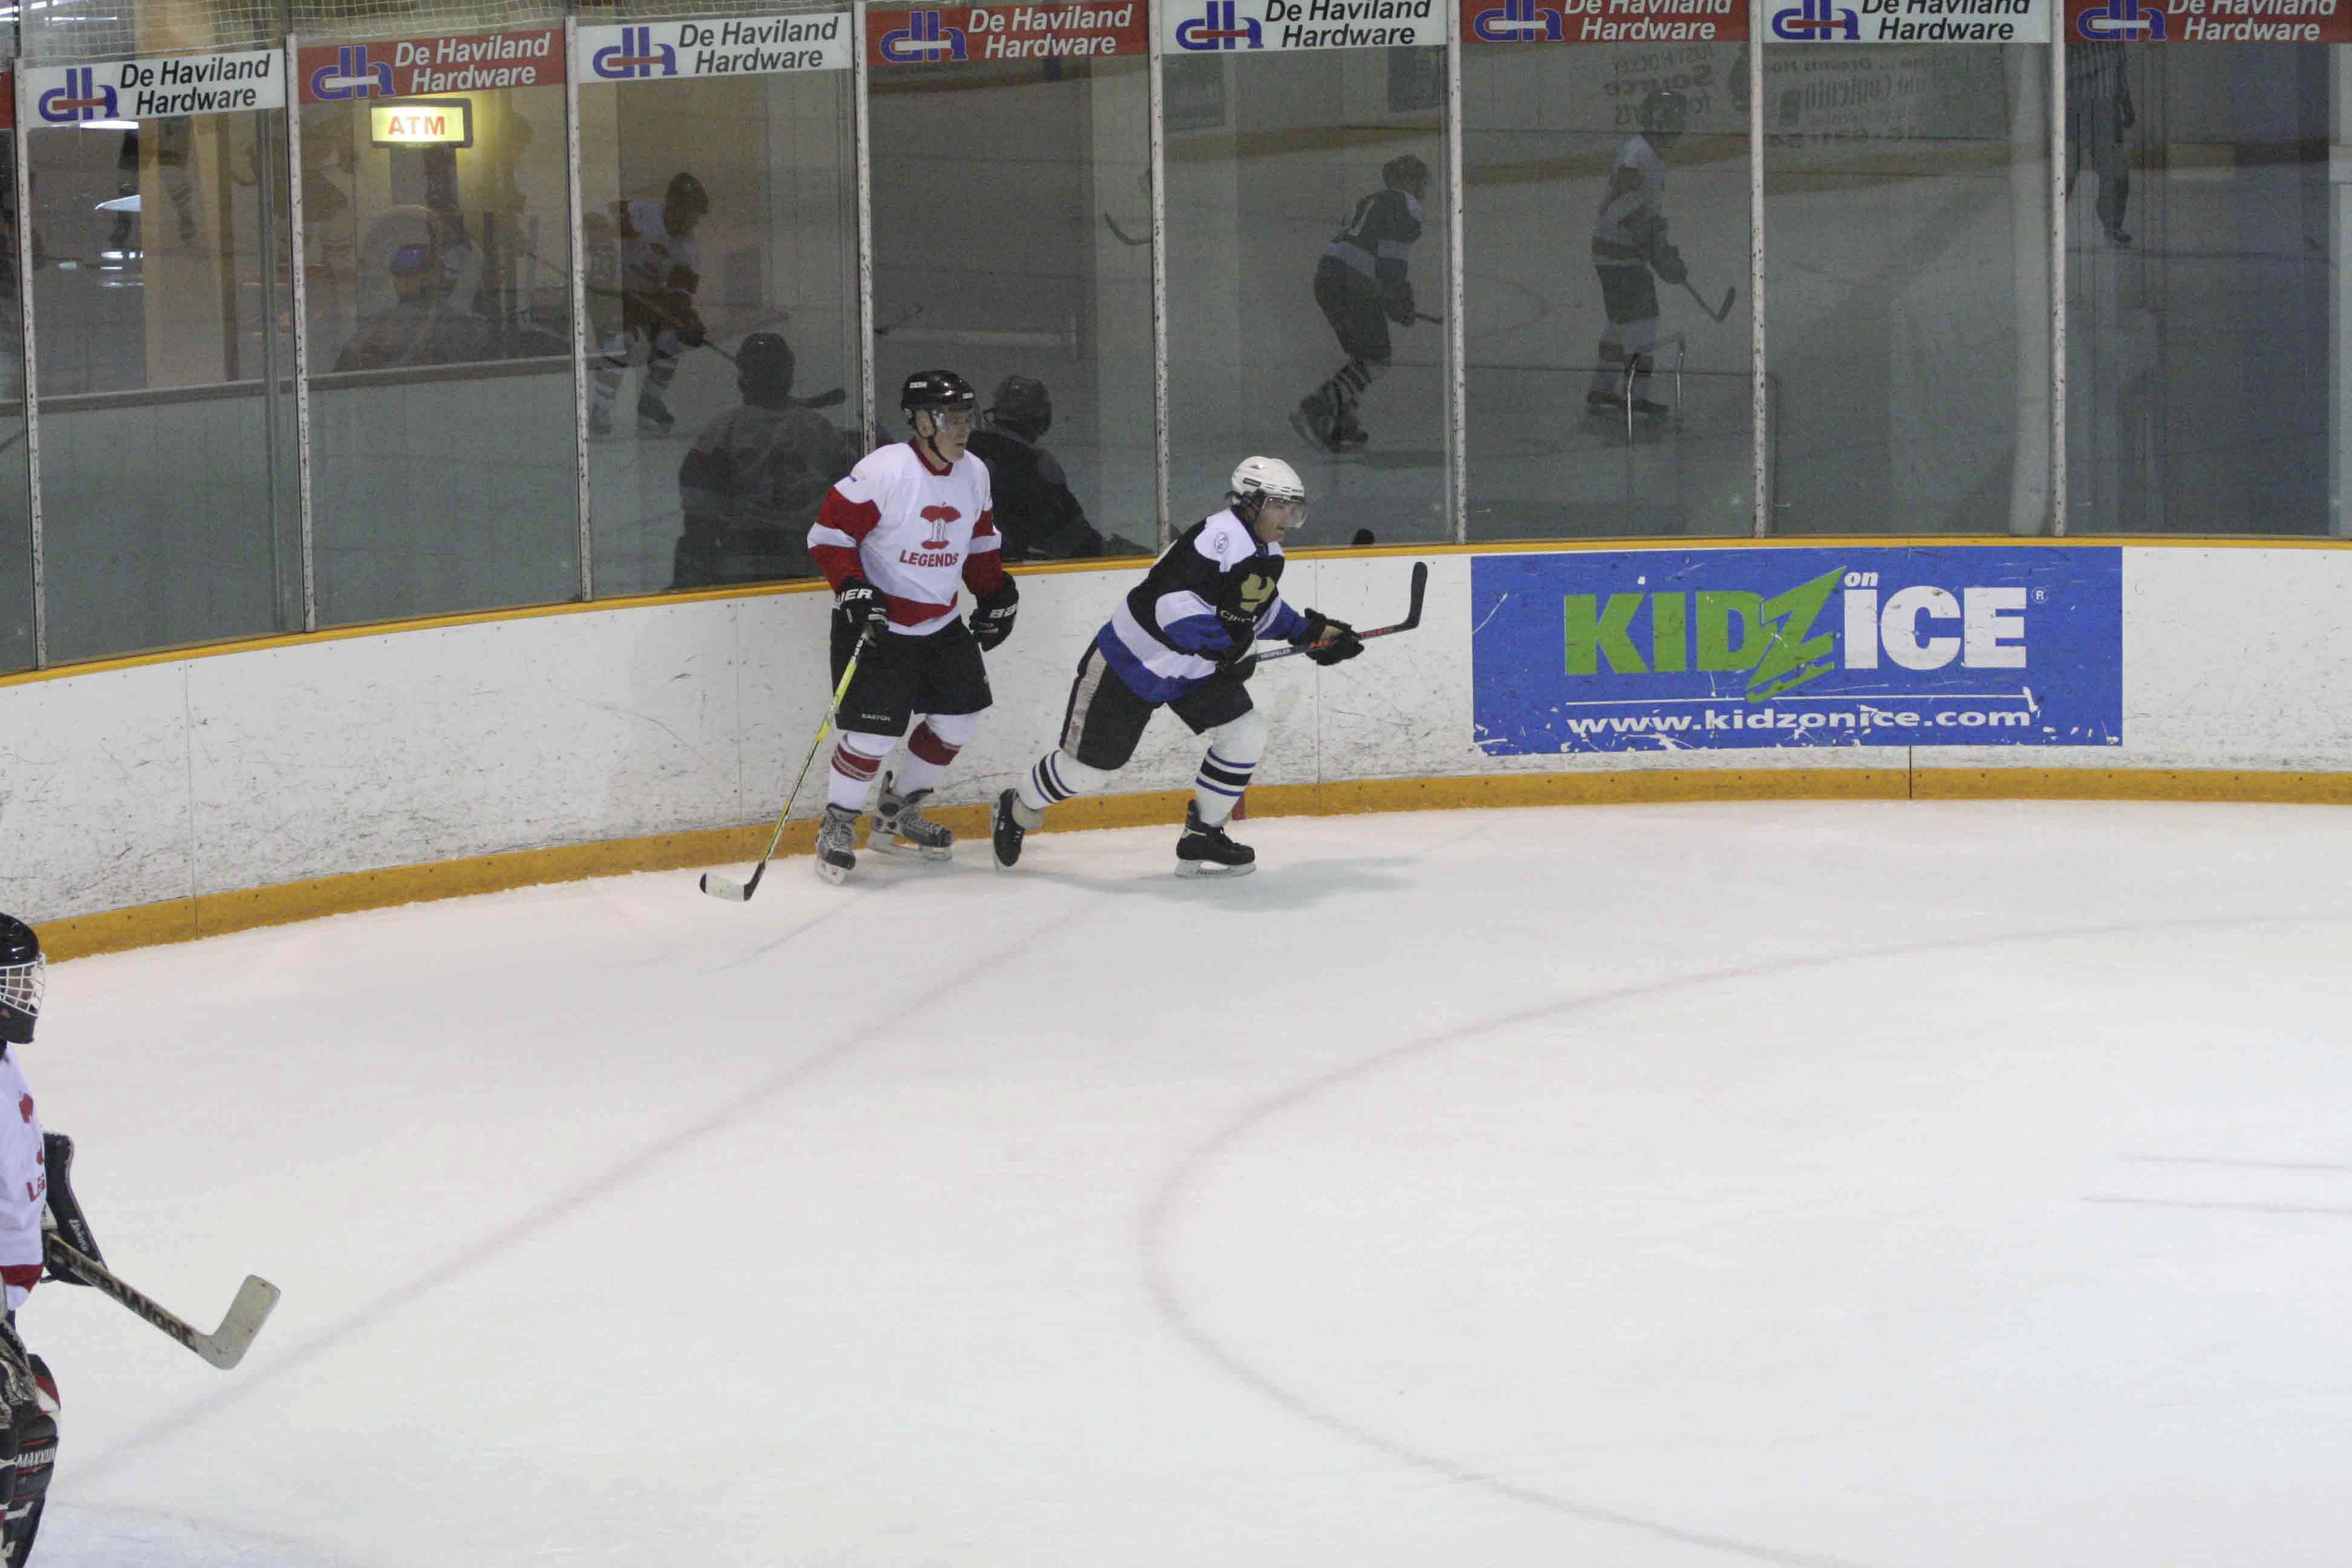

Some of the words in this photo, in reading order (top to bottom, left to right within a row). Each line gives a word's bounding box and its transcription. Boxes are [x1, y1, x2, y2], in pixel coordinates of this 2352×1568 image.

[968, 8, 1005, 33] De
[1011, 4, 1133, 31] Haviland
[1265, 0, 1303, 22] De
[1309, 0, 1431, 21] Haviland
[1564, 0, 1602, 14] De
[1861, 0, 1898, 14] De
[2167, 0, 2207, 15] De
[679, 24, 714, 48] De
[722, 16, 839, 45] Haviland
[1282, 23, 1416, 48] Hardware
[1580, 17, 1717, 41] Hardware
[1878, 17, 2014, 41] Hardware
[2183, 18, 2321, 41] Hardware
[395, 42, 430, 67] De
[436, 32, 551, 64] Haviland
[985, 33, 1117, 59] Hardware
[121, 64, 154, 89] De
[160, 53, 271, 85] Haviland
[695, 47, 823, 74] Hardware
[411, 65, 537, 93] Hardware
[136, 87, 256, 116] Hardware
[388, 116, 445, 135] ATM
[900, 550, 958, 567] LEGENDS
[1844, 572, 1878, 587] on
[1564, 565, 1847, 704] KIDZ
[1567, 708, 2030, 733] www.kidzonice.com
